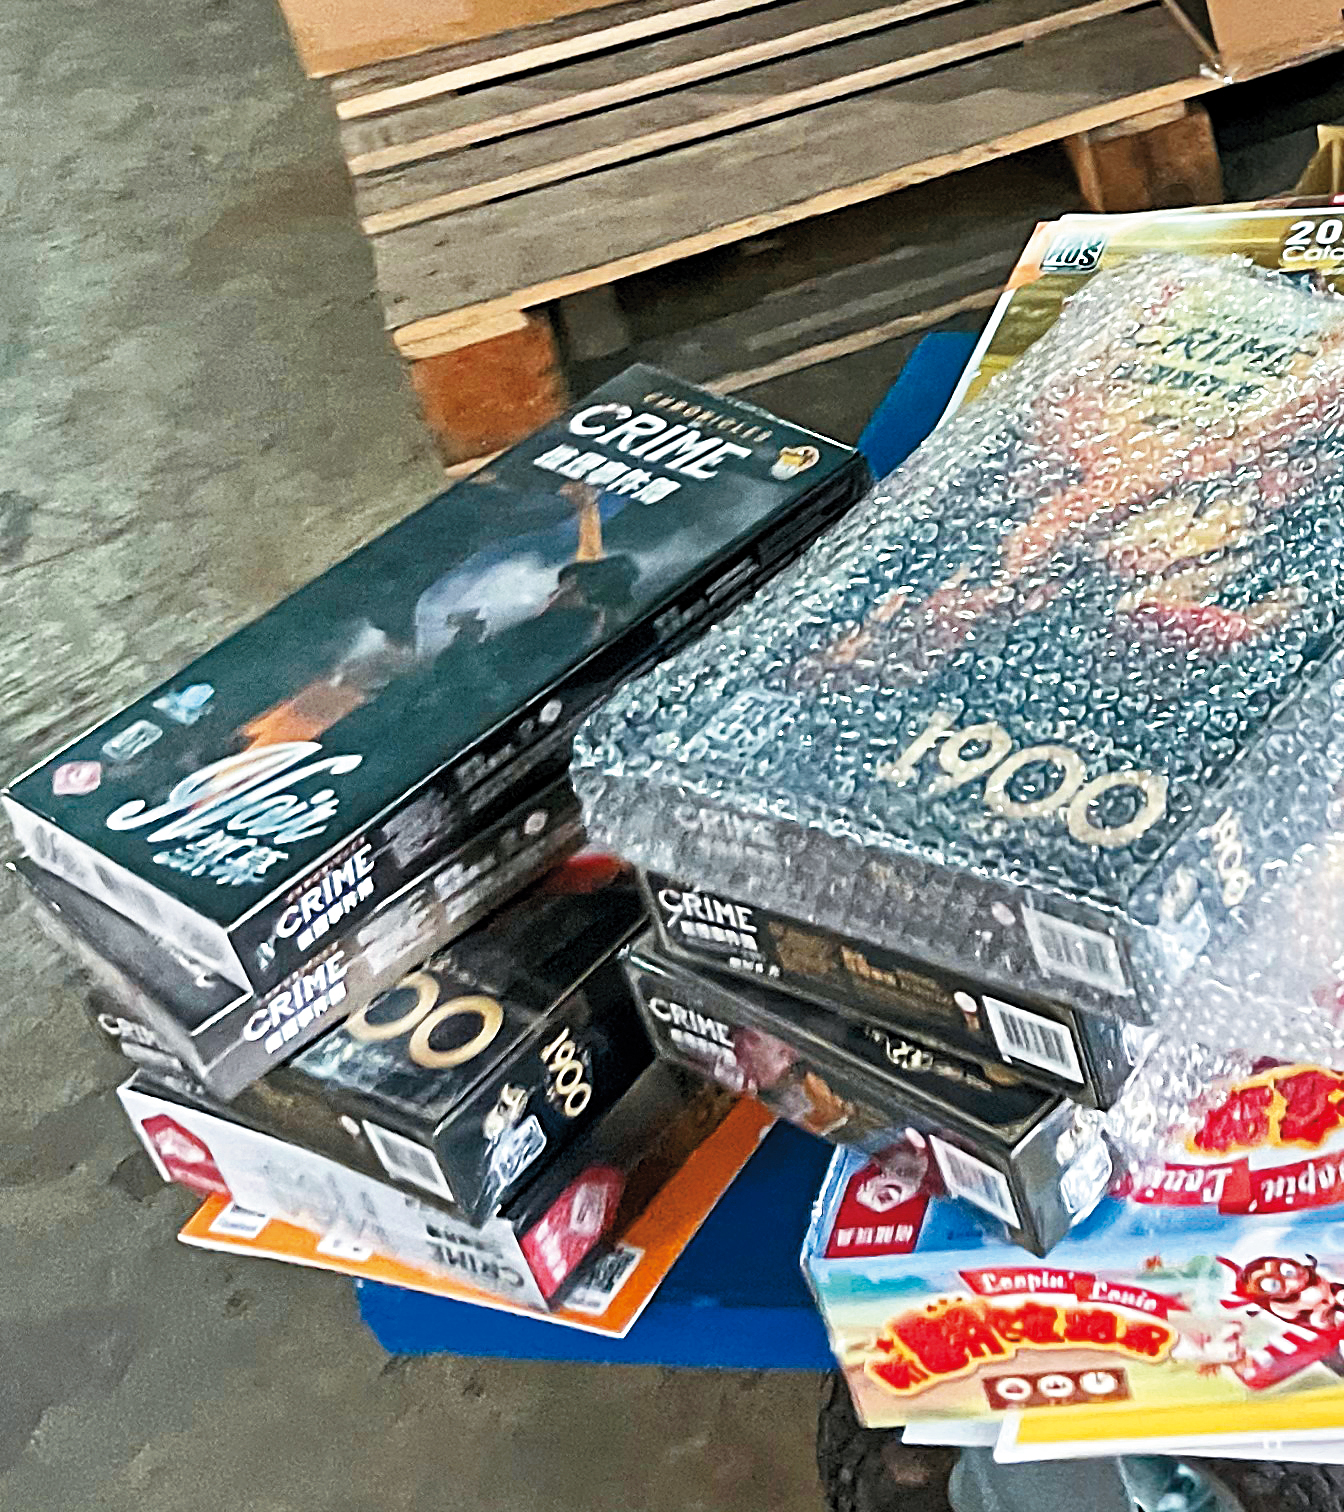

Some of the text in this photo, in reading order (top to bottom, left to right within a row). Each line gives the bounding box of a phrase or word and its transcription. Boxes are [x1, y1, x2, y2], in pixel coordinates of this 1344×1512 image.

[568, 402, 752, 480] CRIME
[276, 843, 375, 939] CRIME
[658, 887, 759, 936] CRIME
[243, 949, 350, 1042] CRIME
[648, 996, 736, 1047] CRIME
[538, 1027, 593, 1120] 1900
